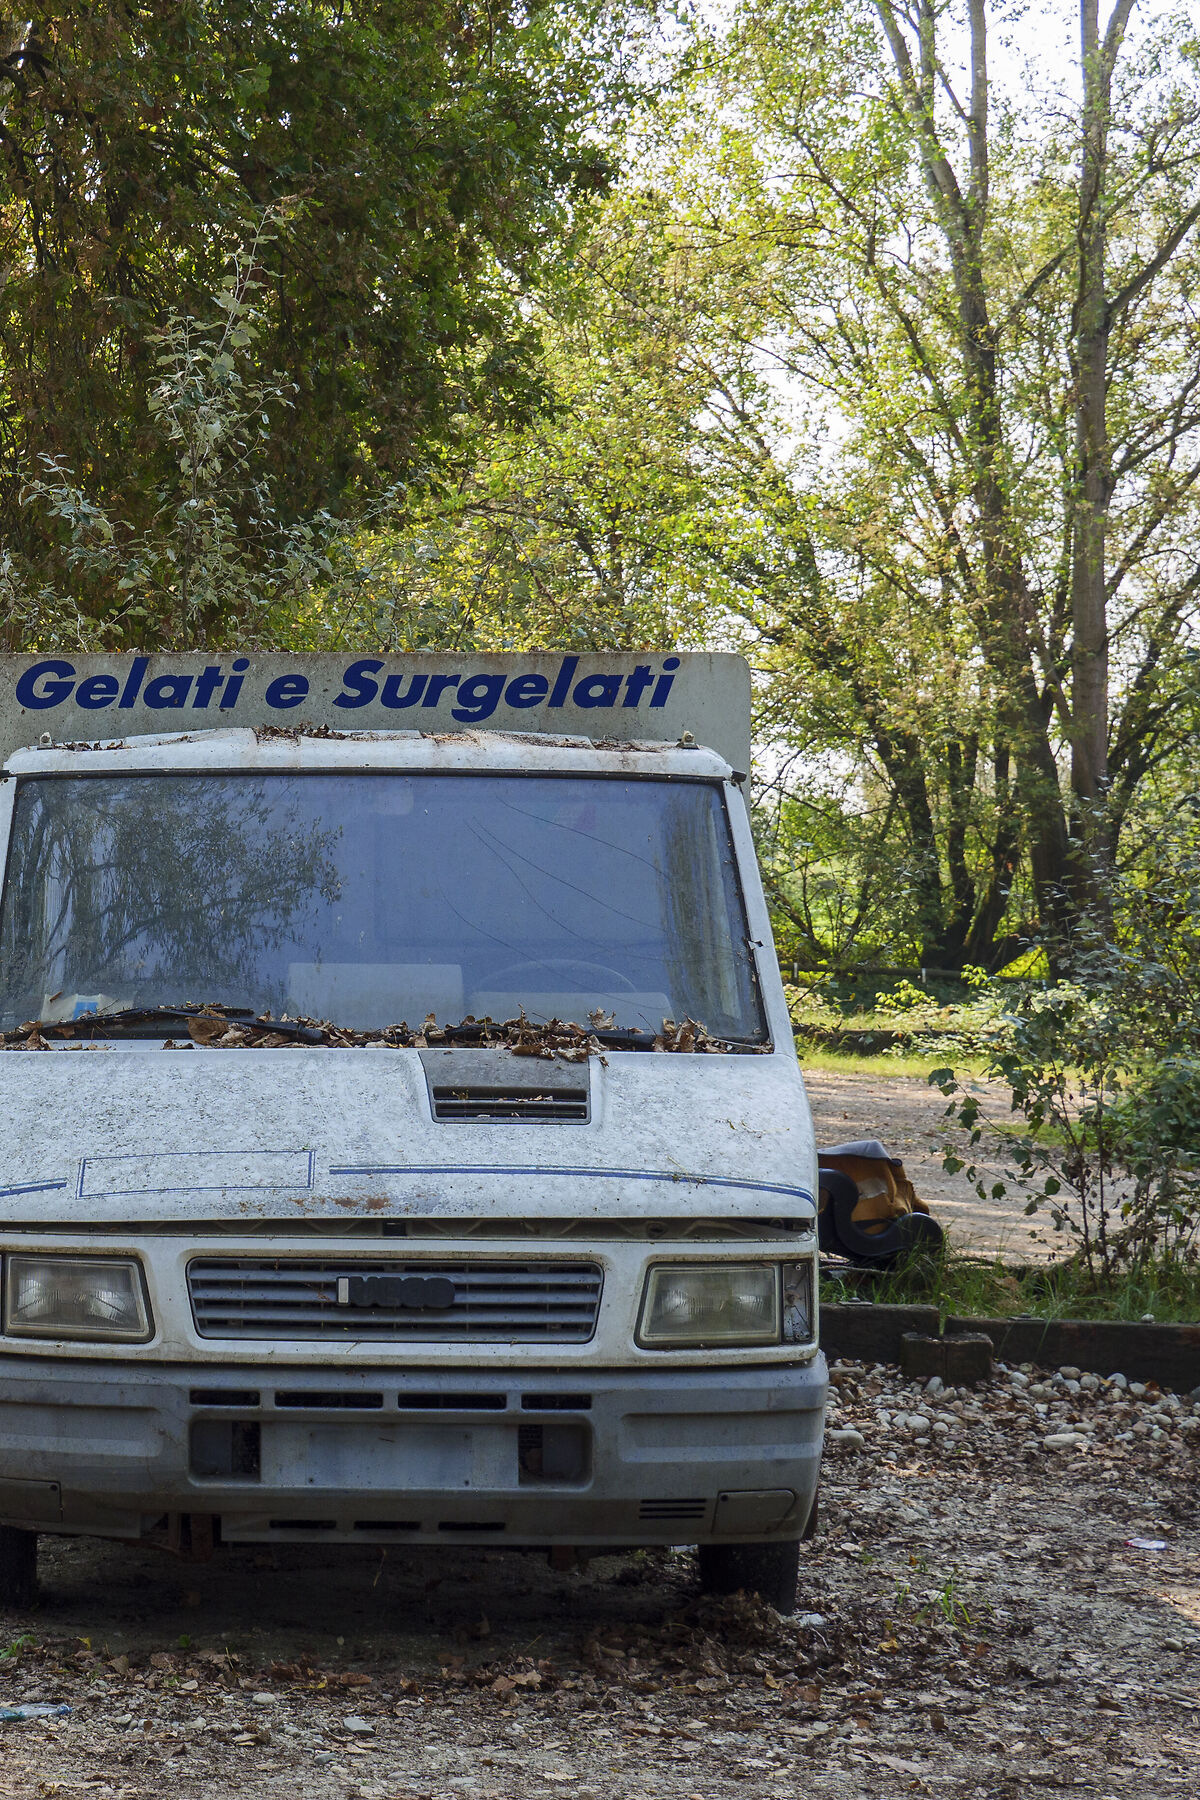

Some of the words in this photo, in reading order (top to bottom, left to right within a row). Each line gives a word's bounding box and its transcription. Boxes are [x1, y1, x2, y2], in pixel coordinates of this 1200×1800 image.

[16, 657, 250, 710] Gelati
[265, 674, 309, 709] e
[332, 656, 680, 723] Surgelati
